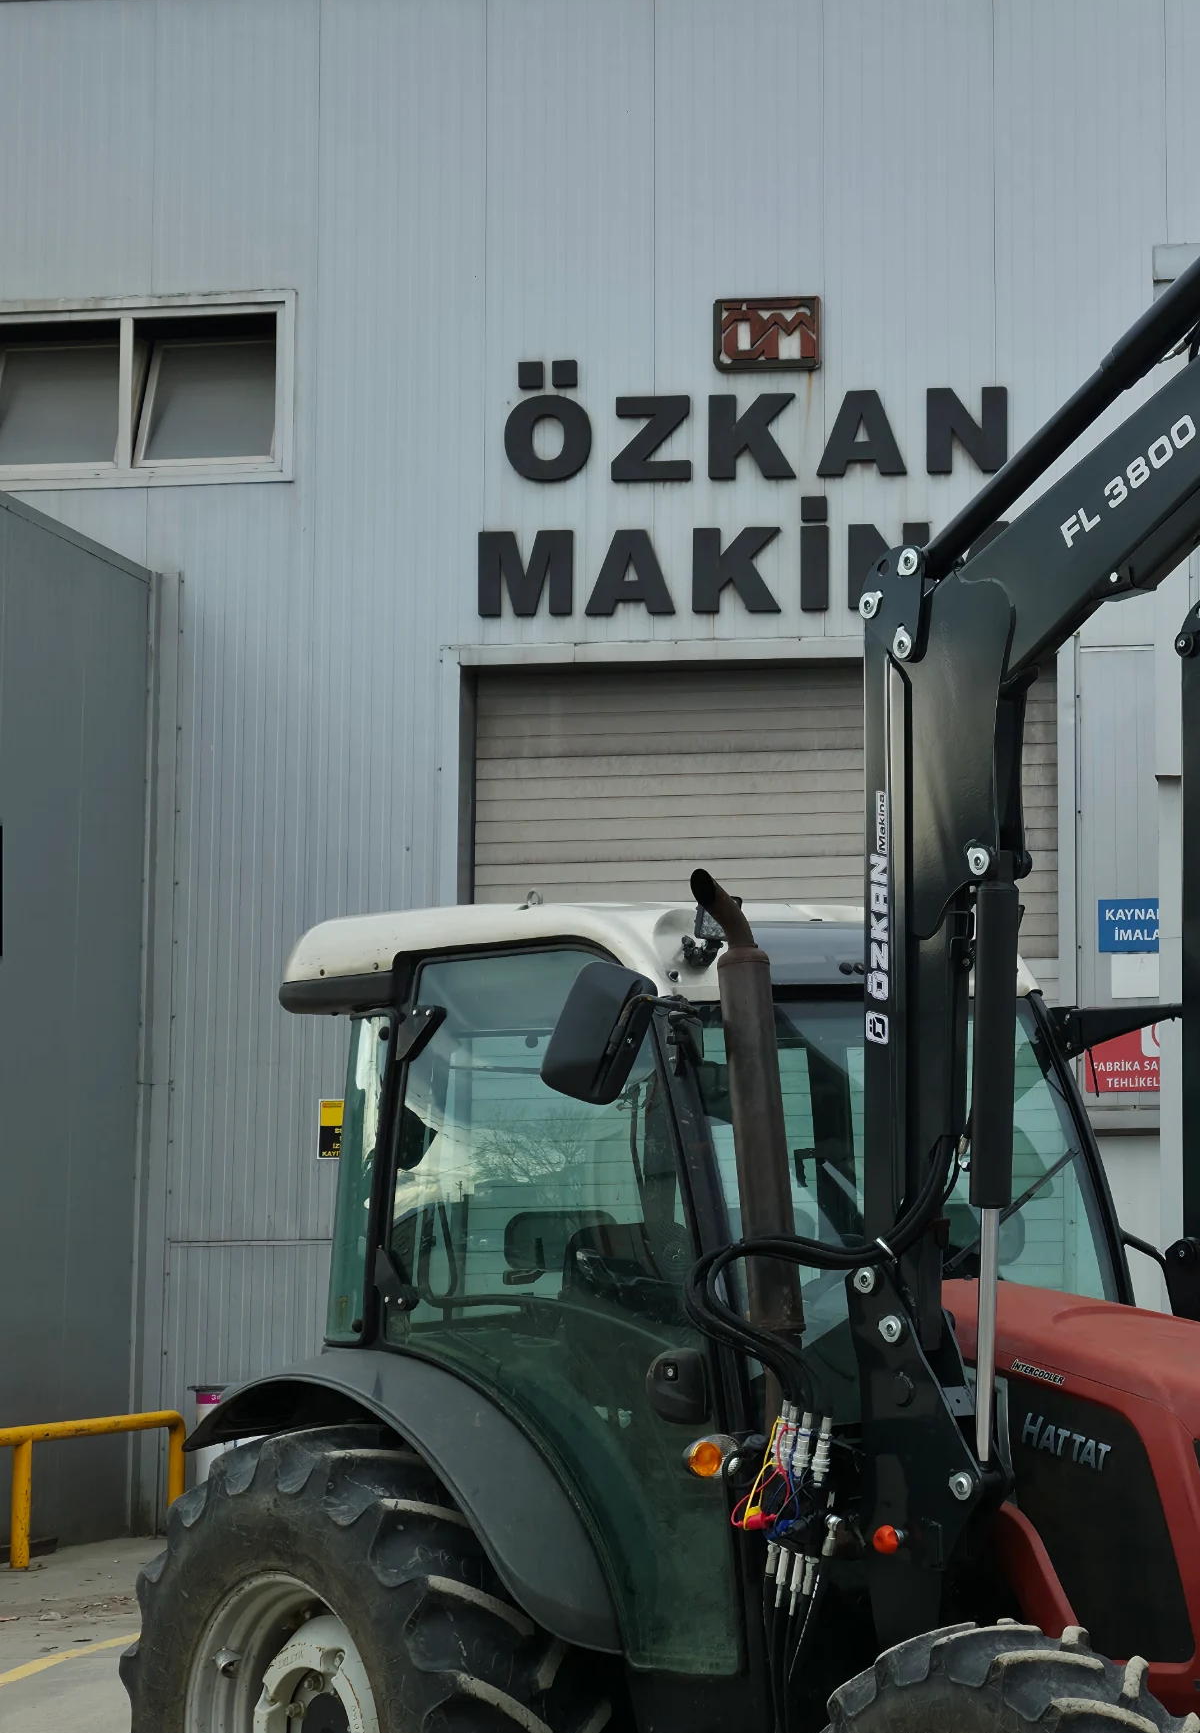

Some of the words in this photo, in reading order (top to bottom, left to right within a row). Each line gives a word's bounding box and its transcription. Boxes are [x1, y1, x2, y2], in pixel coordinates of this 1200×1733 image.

[504, 360, 1008, 482] ÖZKAN
[1060, 507, 1101, 549] FL
[1104, 414, 1197, 508] 3800
[477, 496, 1012, 618] MAKİN
[867, 854, 889, 1001] ÖZKAN
[878, 793, 887, 853] Makina
[1106, 1075, 1160, 1088] TEHLİKEL
[1021, 1412, 1112, 1472] HATTAT
